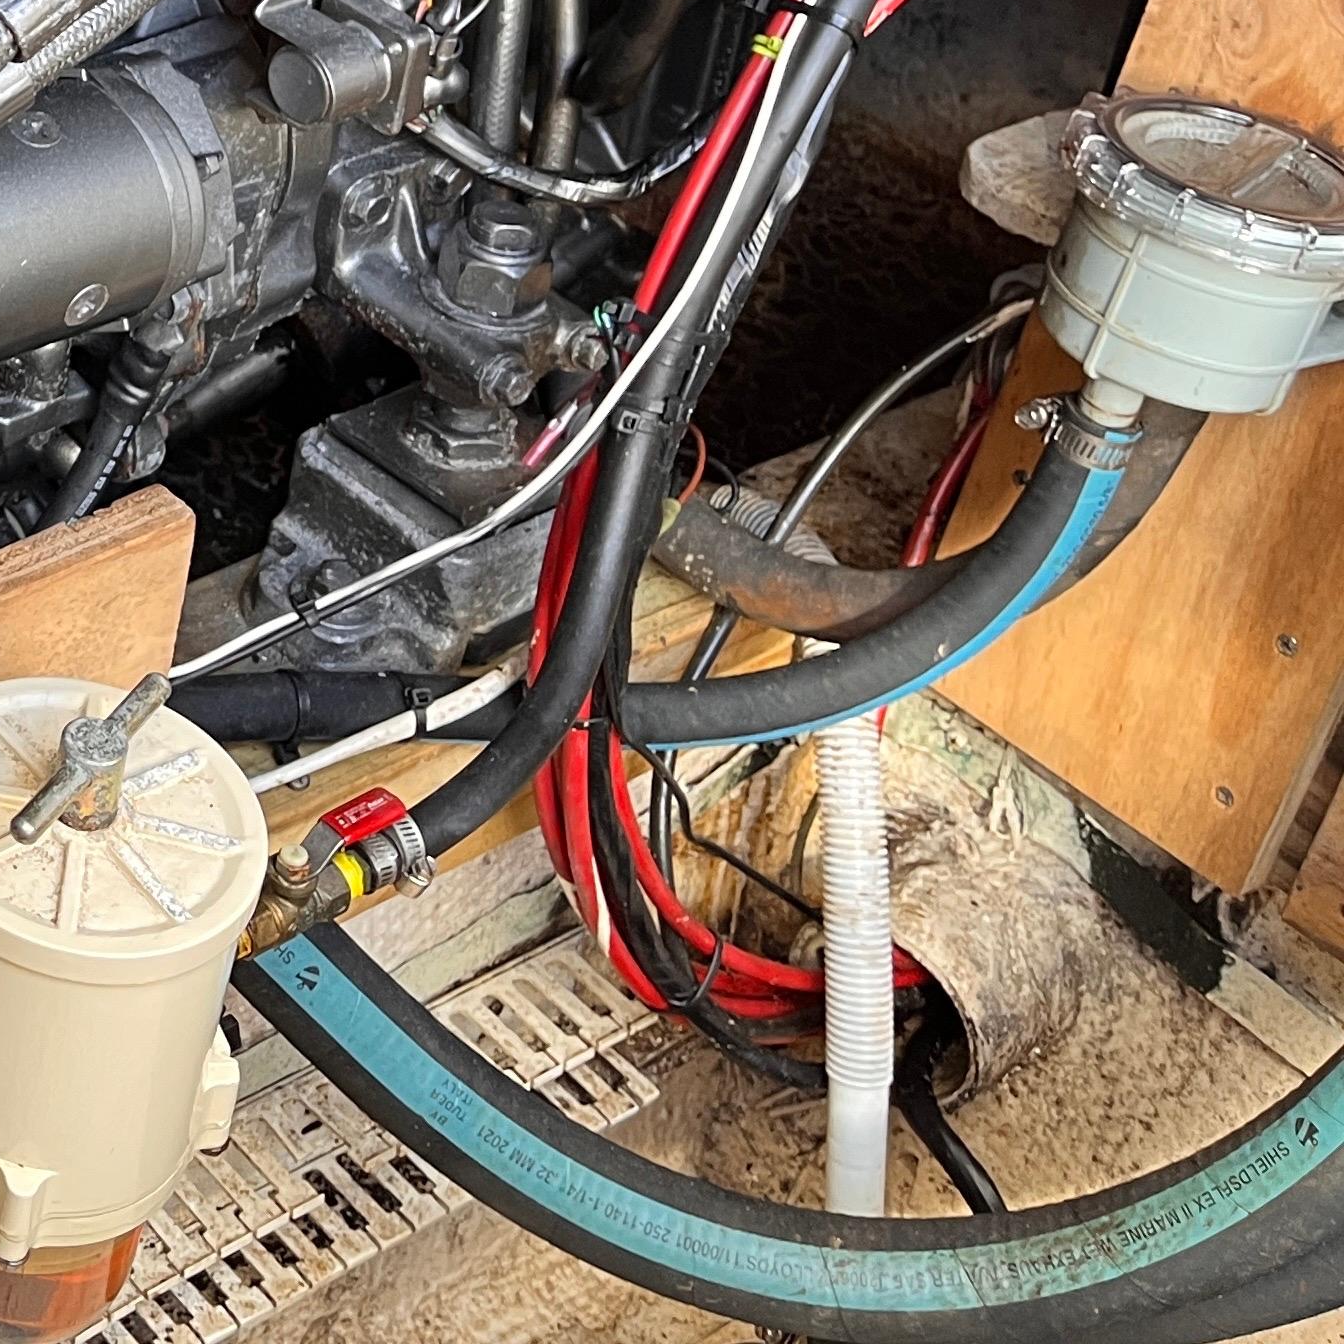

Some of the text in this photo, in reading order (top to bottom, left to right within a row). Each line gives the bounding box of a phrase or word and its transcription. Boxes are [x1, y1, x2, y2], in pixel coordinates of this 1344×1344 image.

[442, 1077, 475, 1106] ITALY
[475, 1123, 510, 1154] 2021
[508, 1146, 537, 1172] MM
[1190, 1139, 1291, 1214] SHIELDSFLEX
[603, 1202, 672, 1244] 250-1140
[1179, 1202, 1194, 1220] II
[1116, 1207, 1182, 1250] MARINE
[674, 1232, 742, 1266] 11/00001
[745, 1255, 813, 1280] LLOYDS
